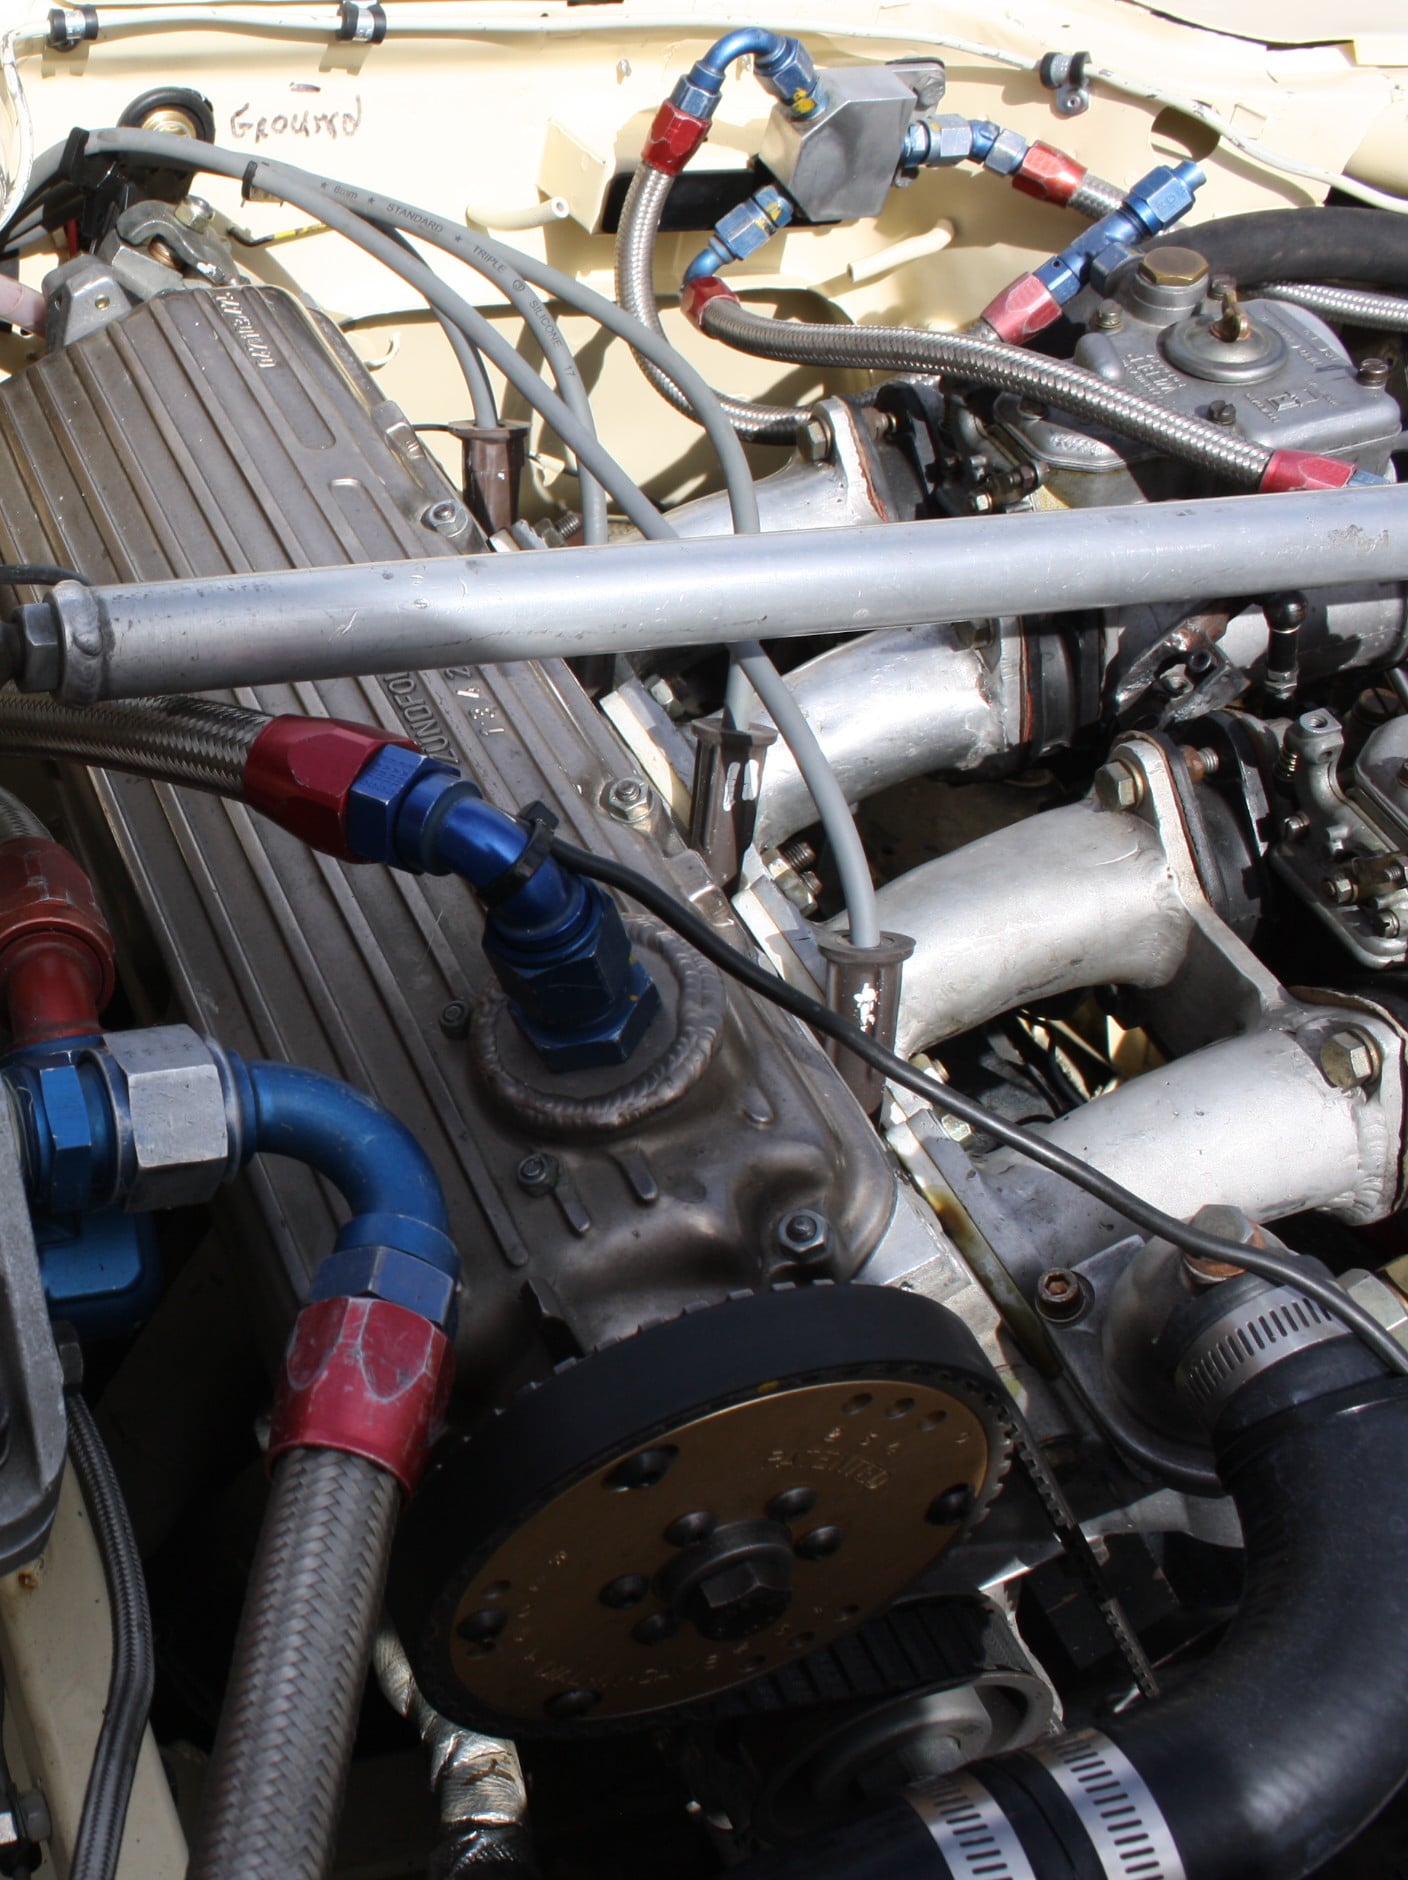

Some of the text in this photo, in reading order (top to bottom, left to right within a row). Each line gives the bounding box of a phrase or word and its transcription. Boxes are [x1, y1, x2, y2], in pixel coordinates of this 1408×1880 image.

[333, 184, 359, 200] 8mm
[386, 202, 444, 234] STANDARD
[472, 244, 507, 274] TRIPLE
[529, 299, 563, 348] SILICONE
